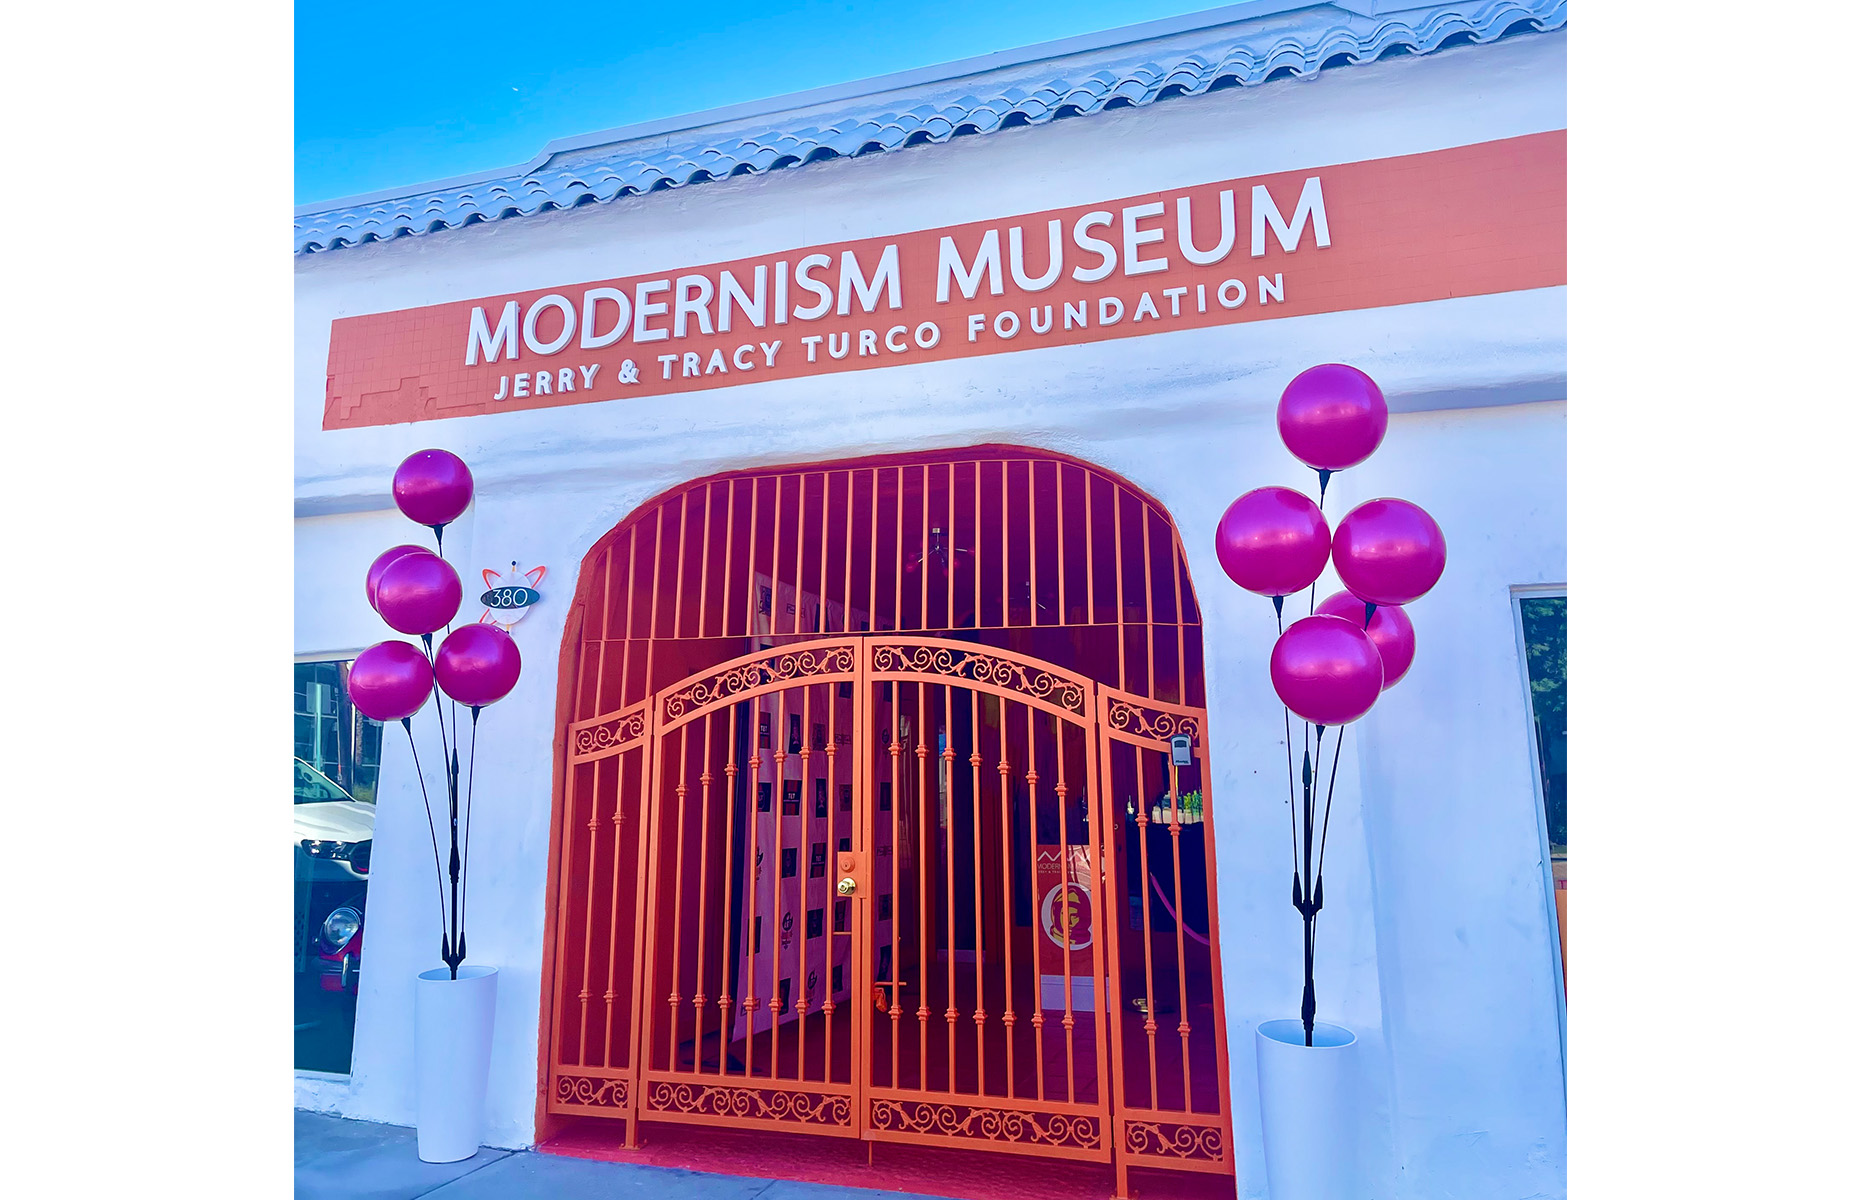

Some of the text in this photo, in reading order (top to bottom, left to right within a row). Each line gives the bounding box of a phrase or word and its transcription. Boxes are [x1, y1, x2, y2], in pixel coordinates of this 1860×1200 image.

[465, 176, 1332, 367] MODERNISM MUSEUM
[493, 273, 1286, 401] JERRY & TRACY TURCO FOUNDATION
[490, 588, 528, 607] 380
